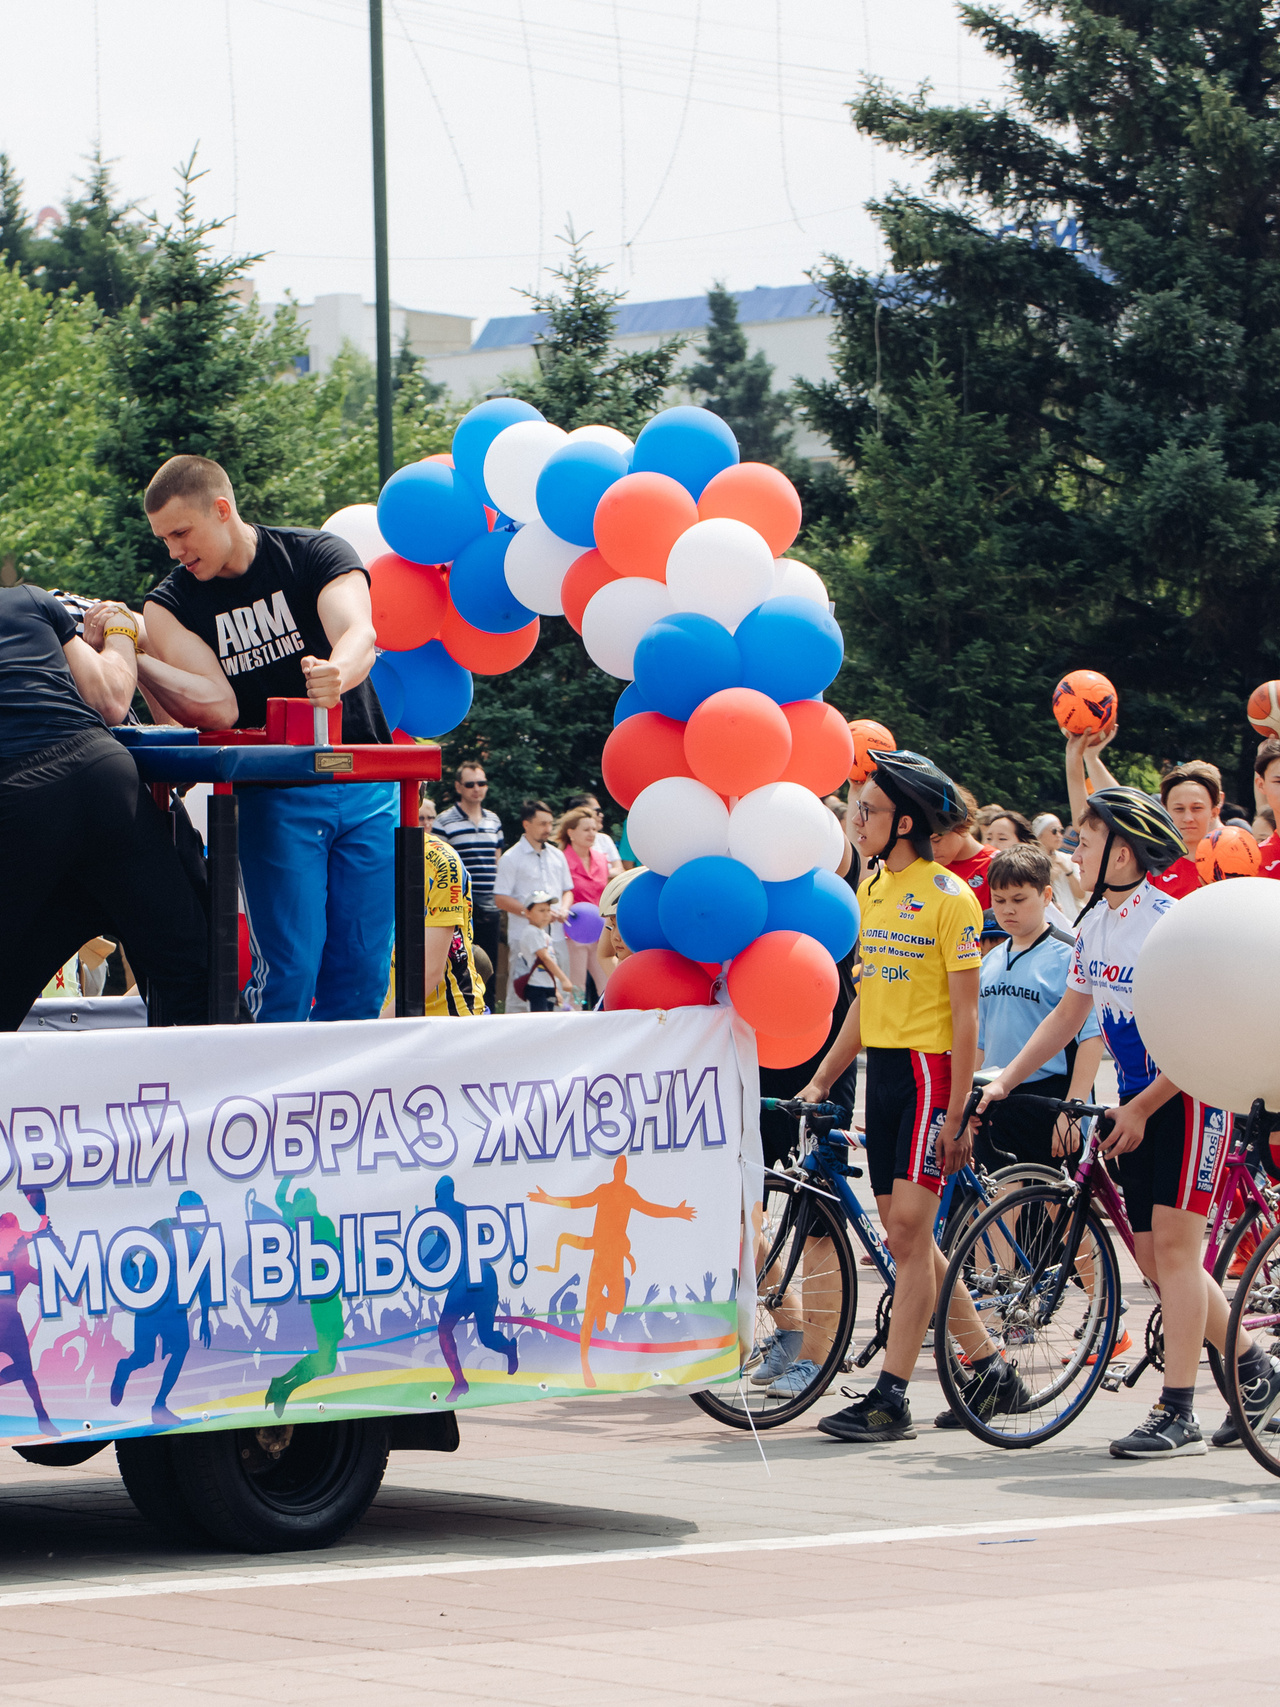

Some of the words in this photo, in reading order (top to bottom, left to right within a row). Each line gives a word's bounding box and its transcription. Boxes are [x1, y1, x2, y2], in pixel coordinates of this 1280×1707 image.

[215, 589, 298, 659] ARM
[220, 631, 306, 677] WRESTLING
[450, 885, 462, 905] Uno
[899, 911, 915, 921] 2010
[878, 945, 886, 953] of
[888, 946, 925, 959] Moscow
[890, 931, 936, 946] МОСКВЫ
[881, 964, 911, 983] epk
[206, 1084, 459, 1180] ОБРАЗ
[461, 1066, 727, 1165] ЖИЗНИ
[32, 1203, 228, 1319] МОЙ
[245, 1202, 530, 1306] ВЫБОР!
[858, 1213, 897, 1282] SOME
